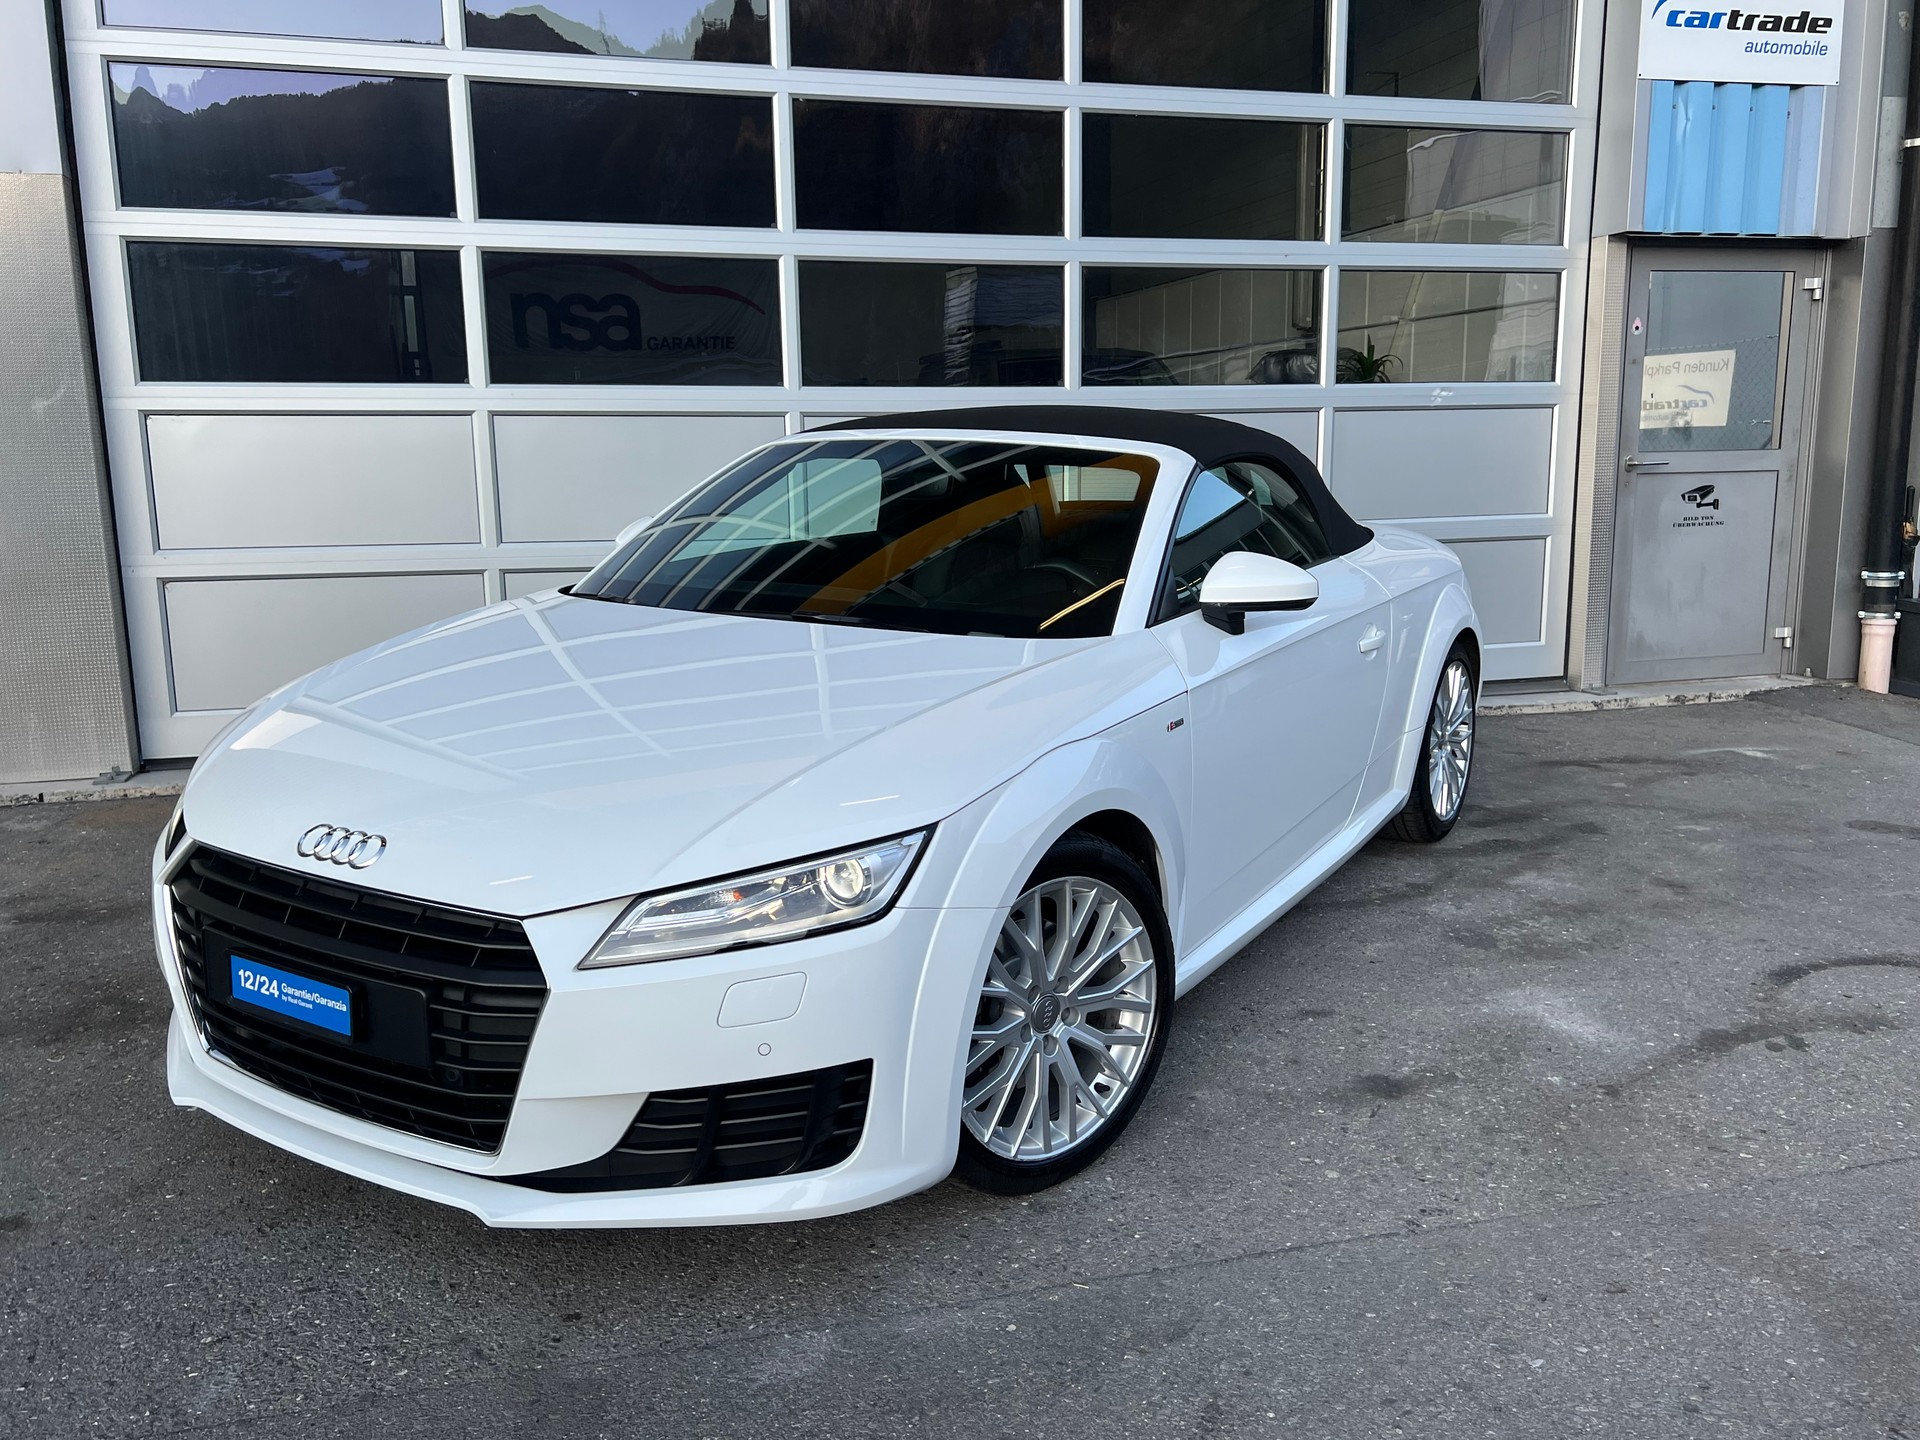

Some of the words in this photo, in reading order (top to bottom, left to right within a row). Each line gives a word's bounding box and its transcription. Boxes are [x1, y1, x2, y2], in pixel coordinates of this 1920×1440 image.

[1666, 10, 1833, 34] cartrade
[1745, 40, 1828, 56] automobile
[510, 292, 643, 350] nsa
[647, 335, 735, 350] GARANTIE
[238, 969, 279, 998] 12/24
[281, 983, 347, 1012] Garantie/Garanzia
